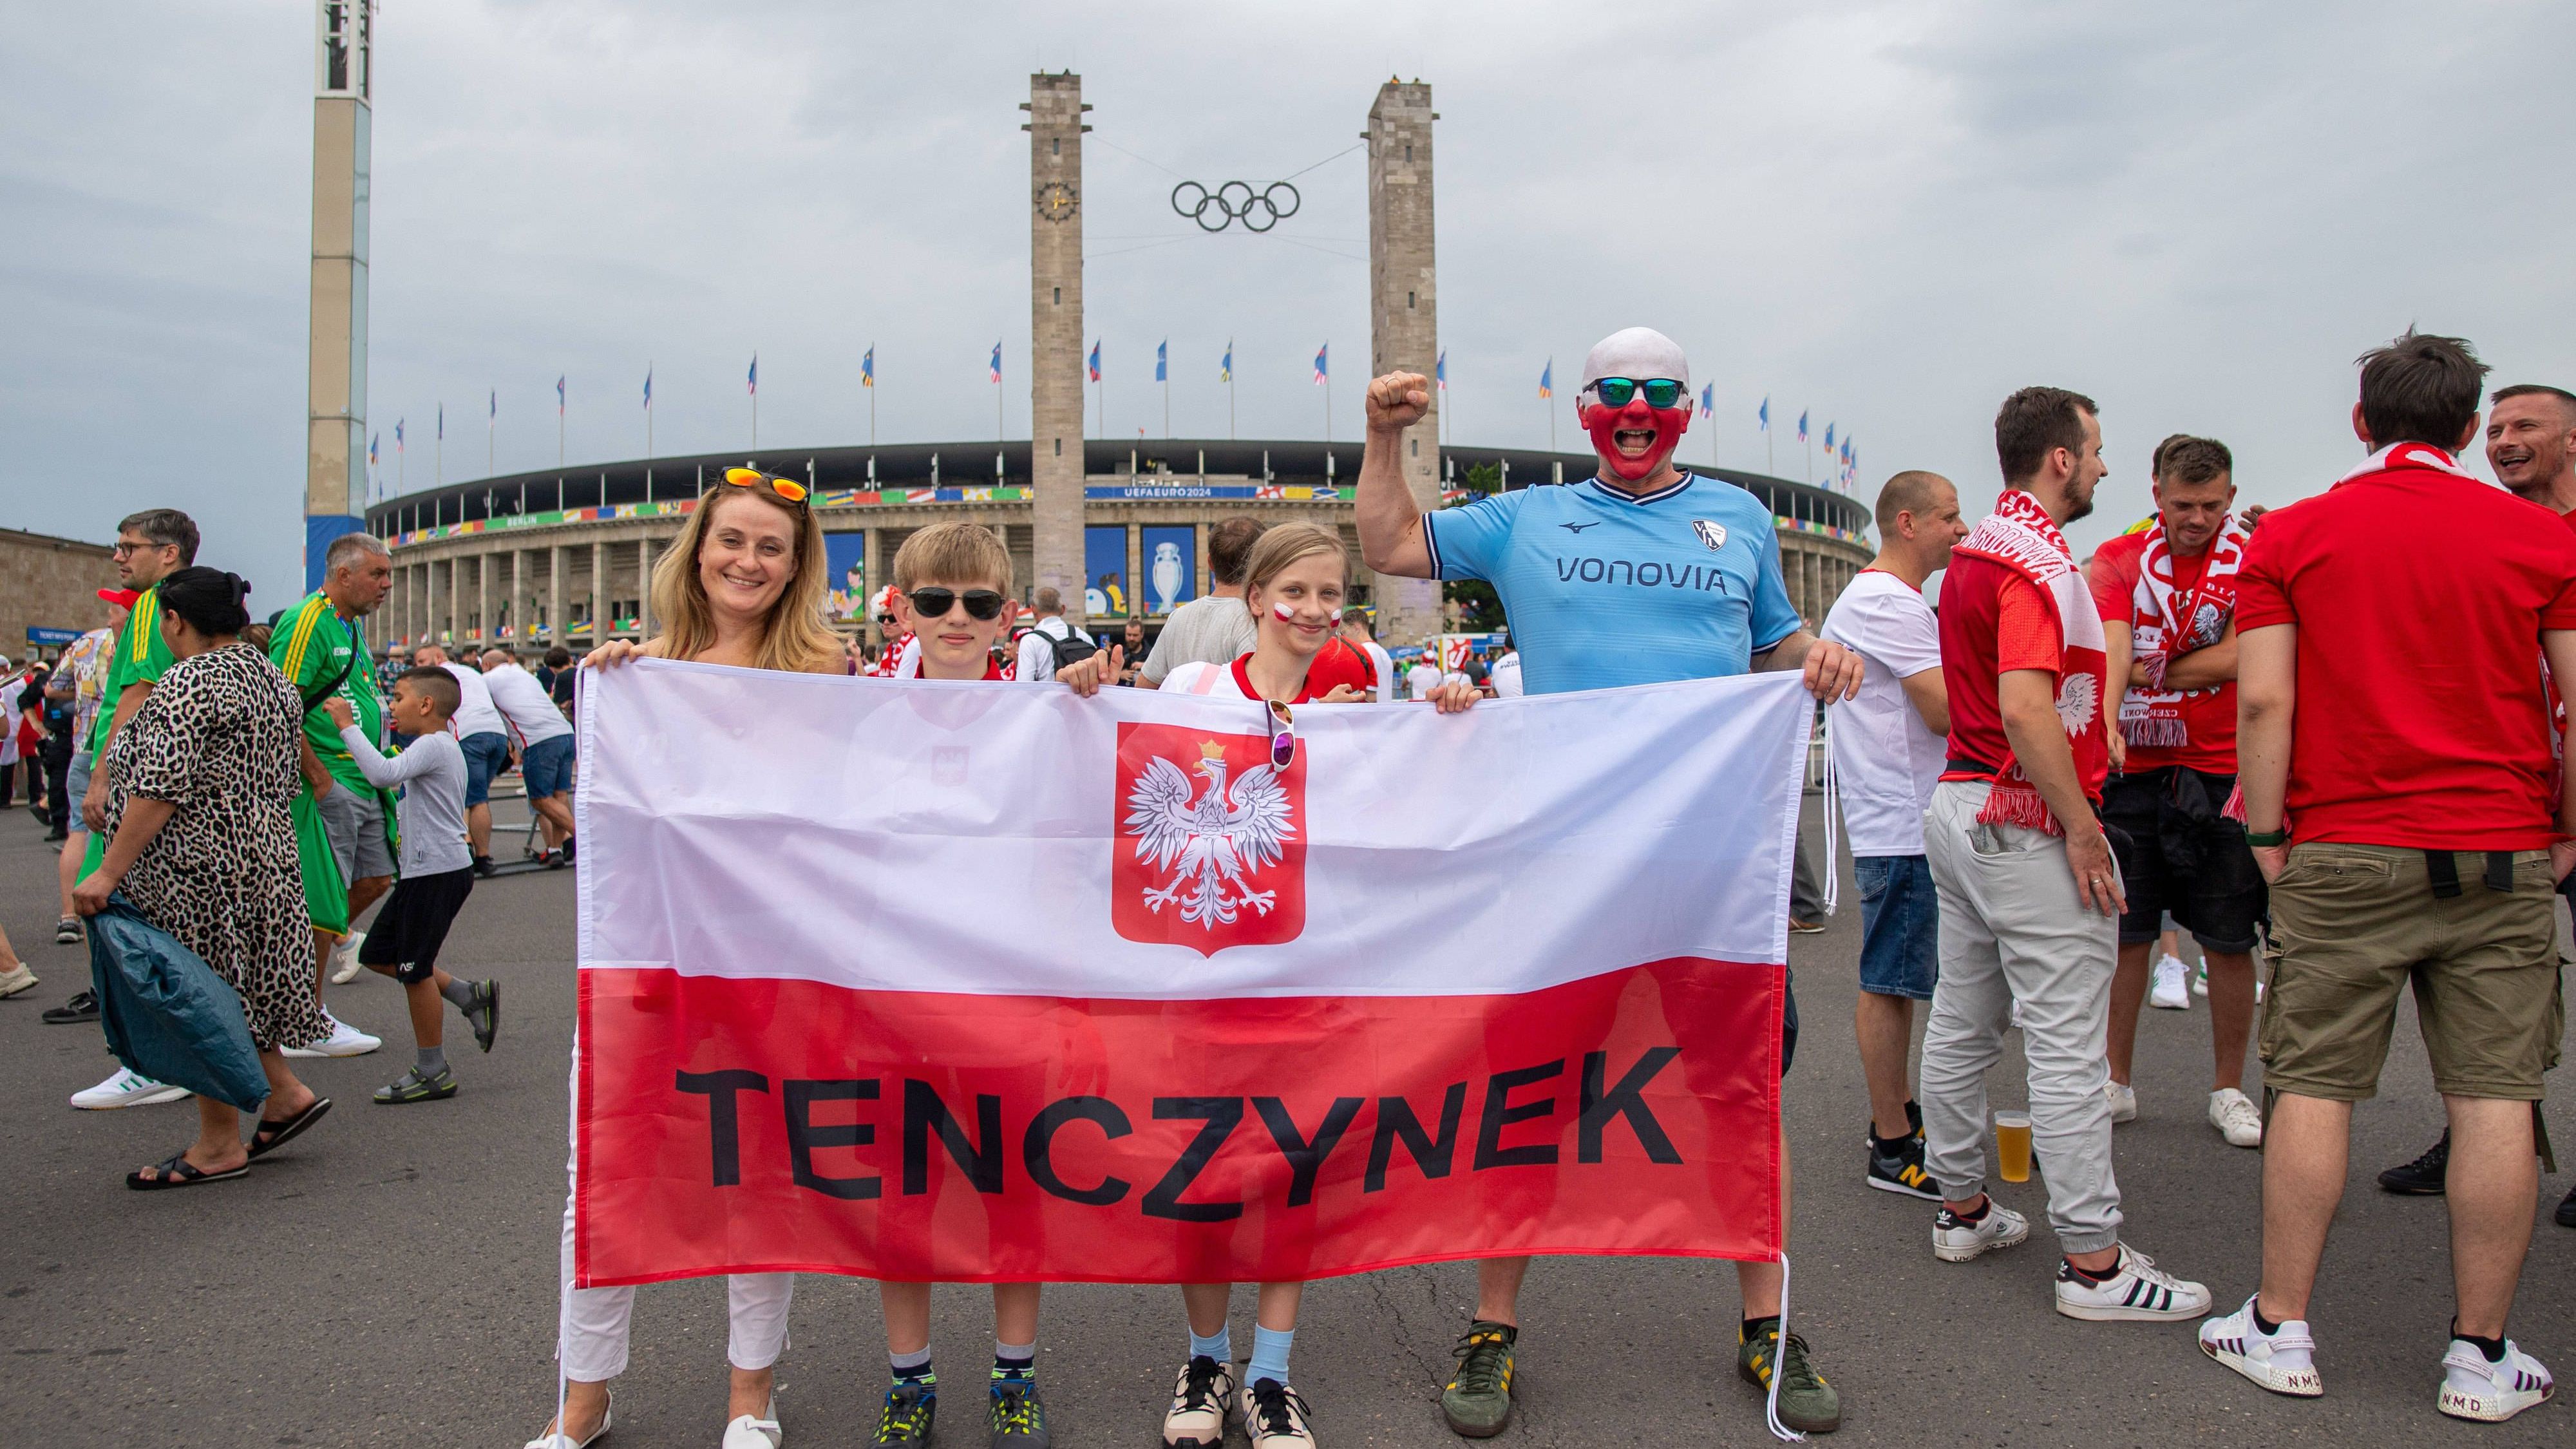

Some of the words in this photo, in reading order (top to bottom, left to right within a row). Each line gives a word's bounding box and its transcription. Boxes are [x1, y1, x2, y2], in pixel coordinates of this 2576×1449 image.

[507, 515, 537, 527] BERLIN
[1557, 557, 1728, 596] VONOVIA
[676, 1046, 1684, 1222] TENCZYNEK
[2442, 1392, 2481, 1412] NMD
